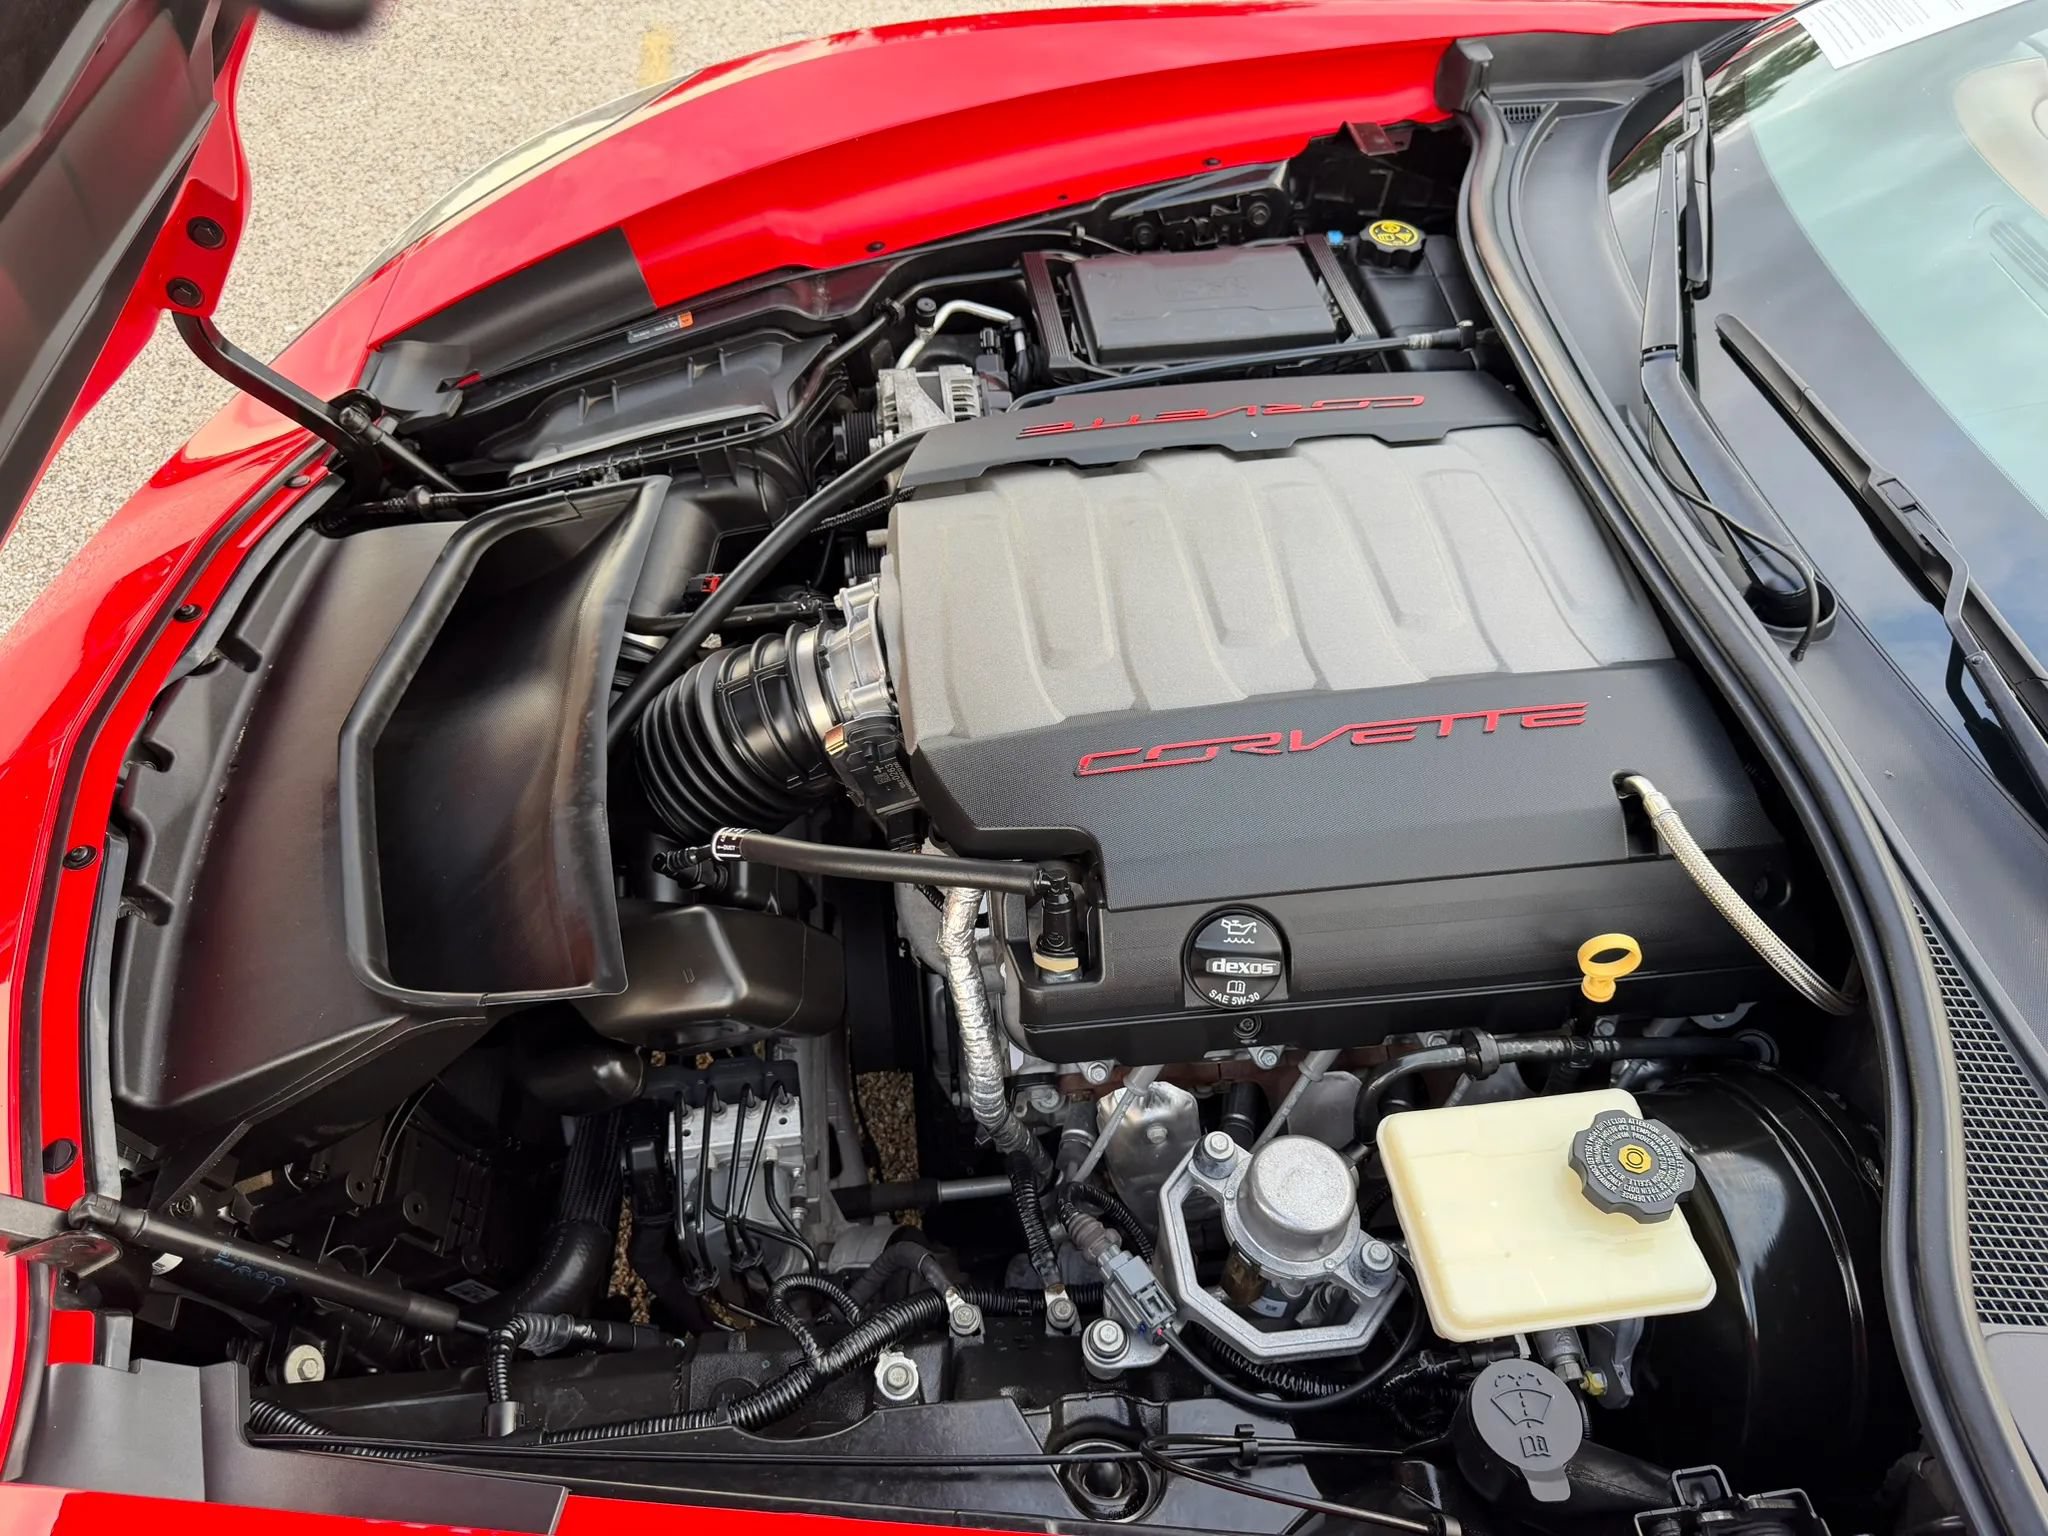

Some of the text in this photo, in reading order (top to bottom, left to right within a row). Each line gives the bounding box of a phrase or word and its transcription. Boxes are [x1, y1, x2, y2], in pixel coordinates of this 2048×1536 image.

[1016, 395, 1425, 439] CORVETTE
[1075, 702, 1589, 776] CORVETTE
[1212, 958, 1276, 974] dexos
[1209, 989, 1260, 1005] SAE 5W-30
[1597, 1164, 1610, 1176] USE
[1606, 1173, 1623, 1188] ONLY
[1605, 1163, 1626, 1182] FILLER
